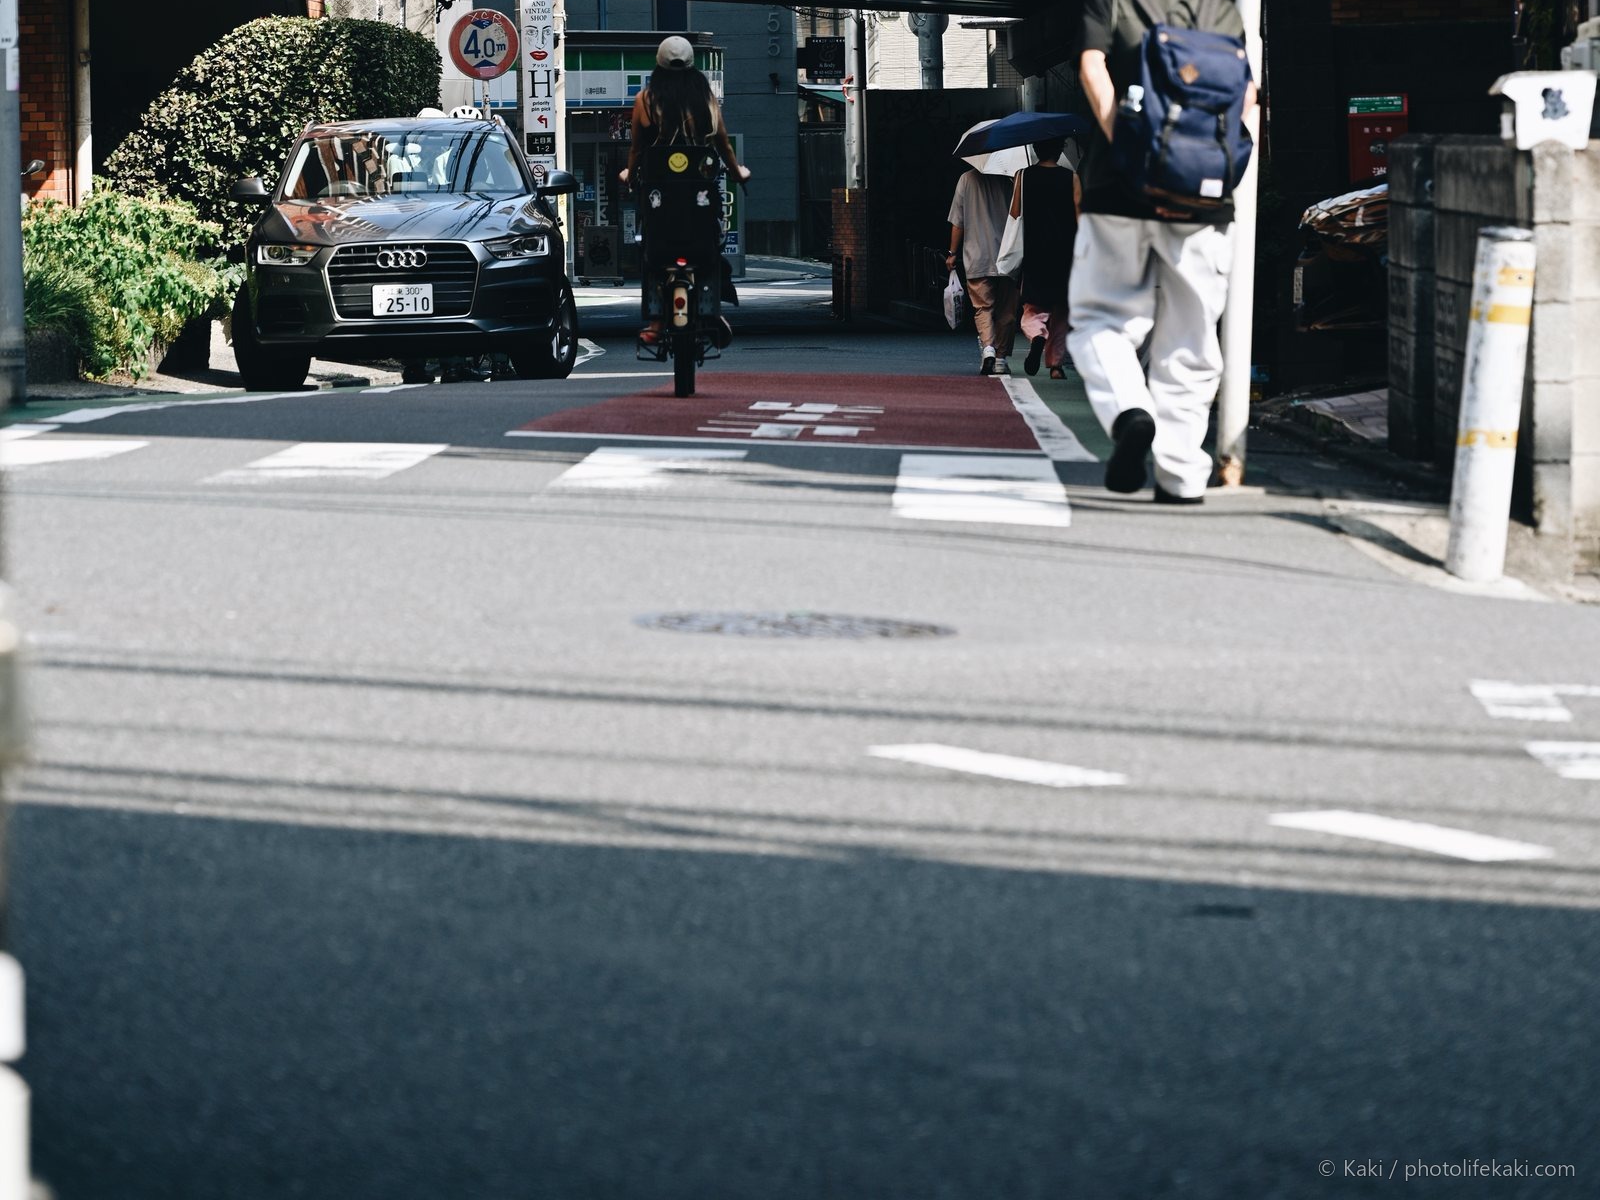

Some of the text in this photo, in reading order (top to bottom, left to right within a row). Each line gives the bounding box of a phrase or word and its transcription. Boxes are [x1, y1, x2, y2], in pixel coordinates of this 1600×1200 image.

[463, 29, 506, 59] 4.0m
[528, 69, 552, 98] H
[405, 287, 420, 295] 300
[386, 296, 430, 313] 25-10
